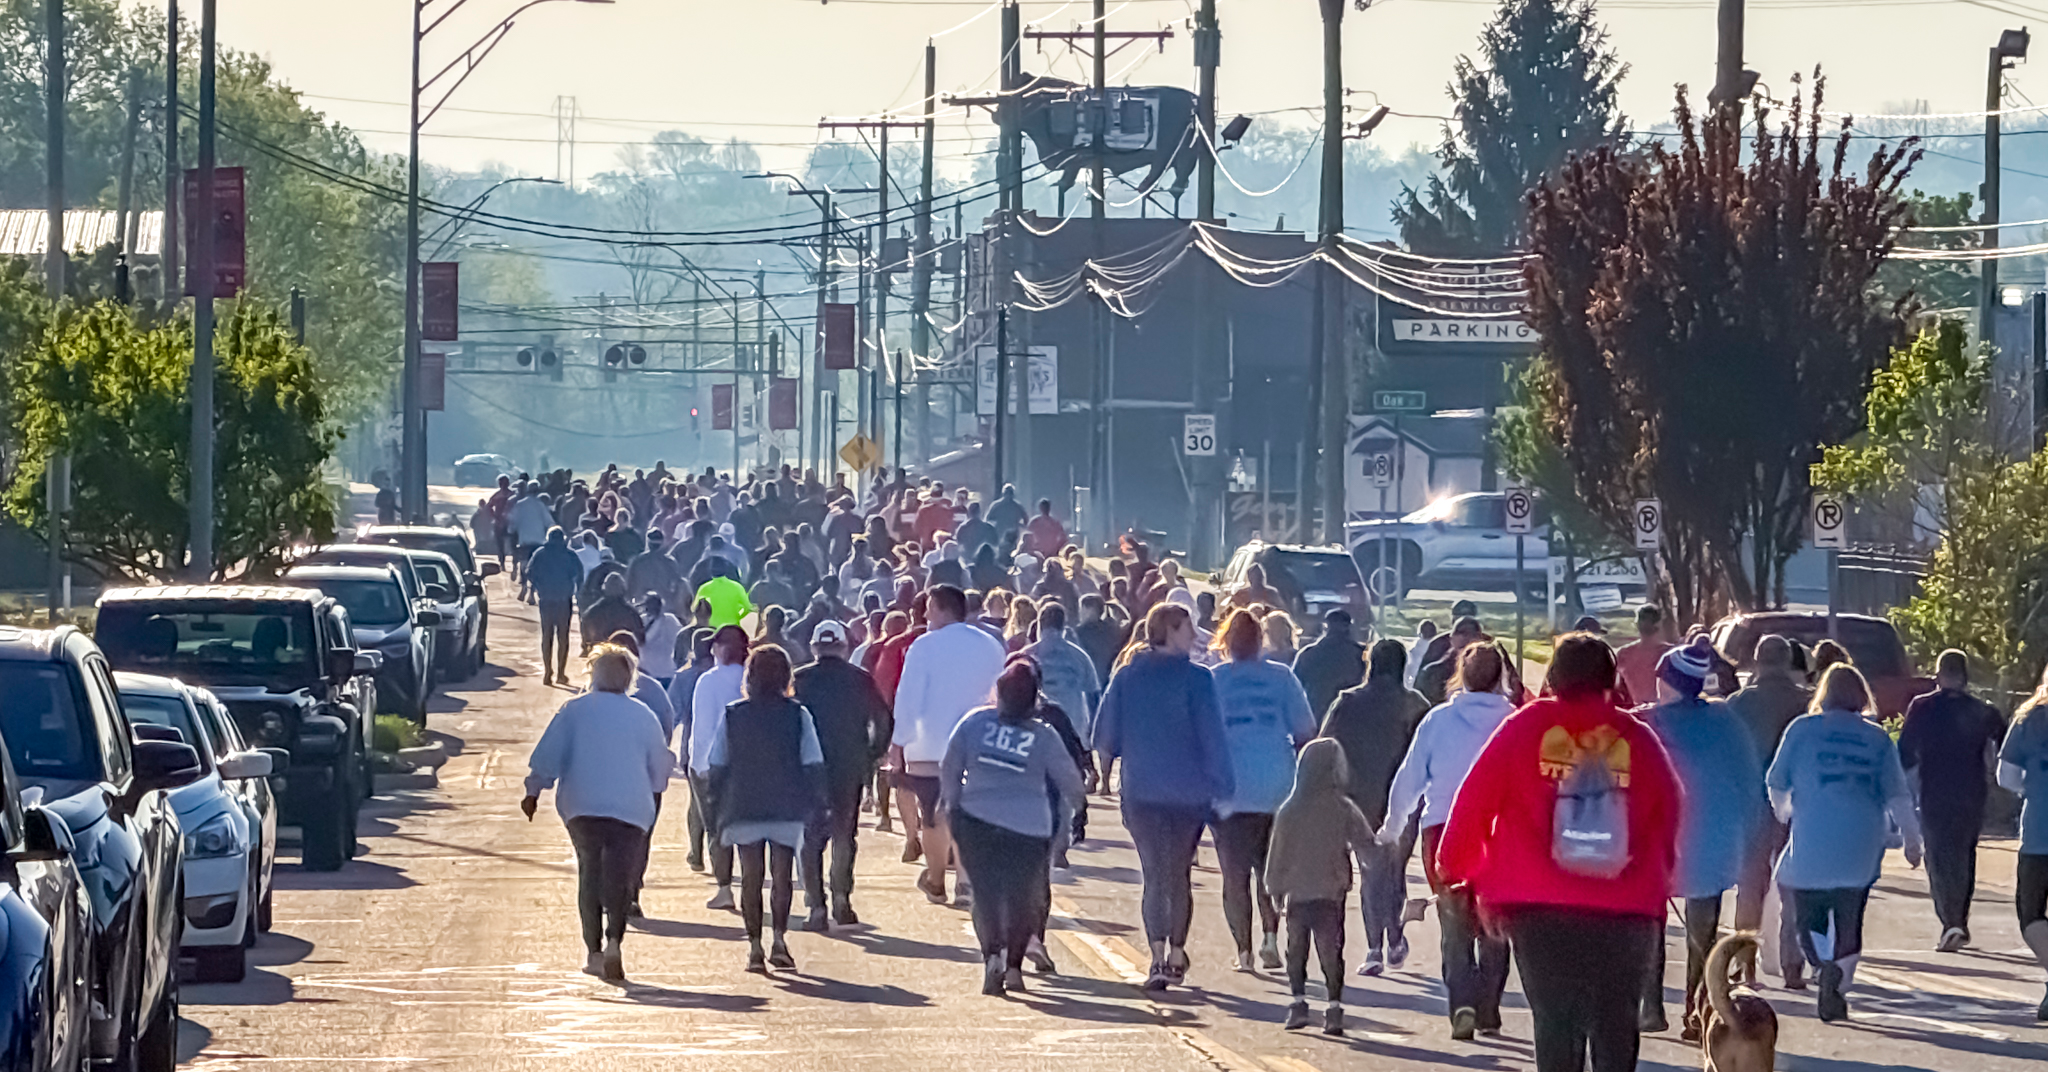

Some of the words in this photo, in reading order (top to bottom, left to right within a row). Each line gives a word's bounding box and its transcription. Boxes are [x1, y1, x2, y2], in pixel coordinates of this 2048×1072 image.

[1411, 322, 1530, 338] PARKING
[1187, 434, 1213, 451] 30
[983, 722, 1035, 757] 26.2
